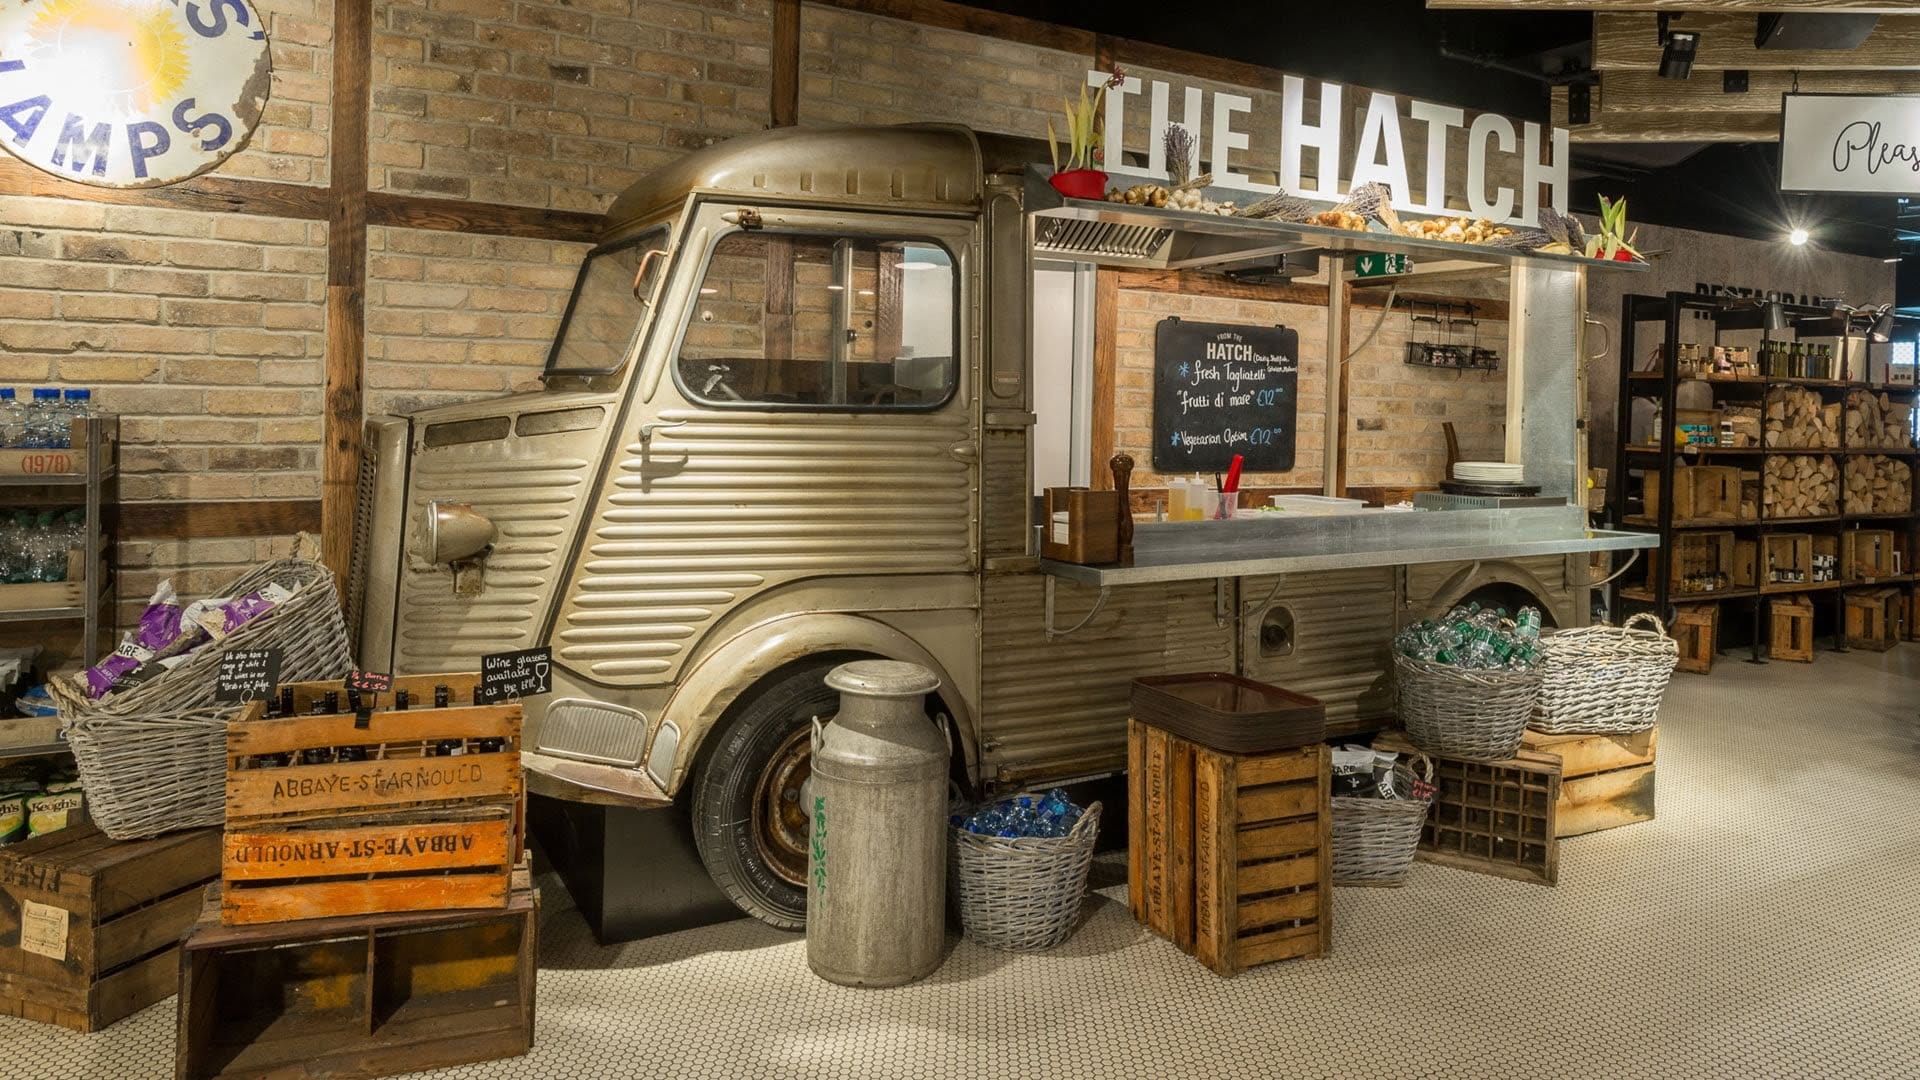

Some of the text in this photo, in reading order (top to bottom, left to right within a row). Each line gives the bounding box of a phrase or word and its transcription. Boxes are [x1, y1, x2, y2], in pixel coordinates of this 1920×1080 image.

[1088, 70, 1569, 227] THE HATCH
[1206, 342, 1253, 362] HATCH
[1191, 360, 1220, 386] fresh
[1214, 391, 1225, 408] di
[1180, 430, 1221, 454] Vegetarian
[1223, 428, 1248, 447] Option
[21, 454, 72, 474] (1978)
[486, 653, 548, 670] Wine glasses
[486, 667, 531, 683] available
[485, 686, 498, 697] at
[503, 683, 517, 693] the
[31, 799, 78, 813] Keogh's
